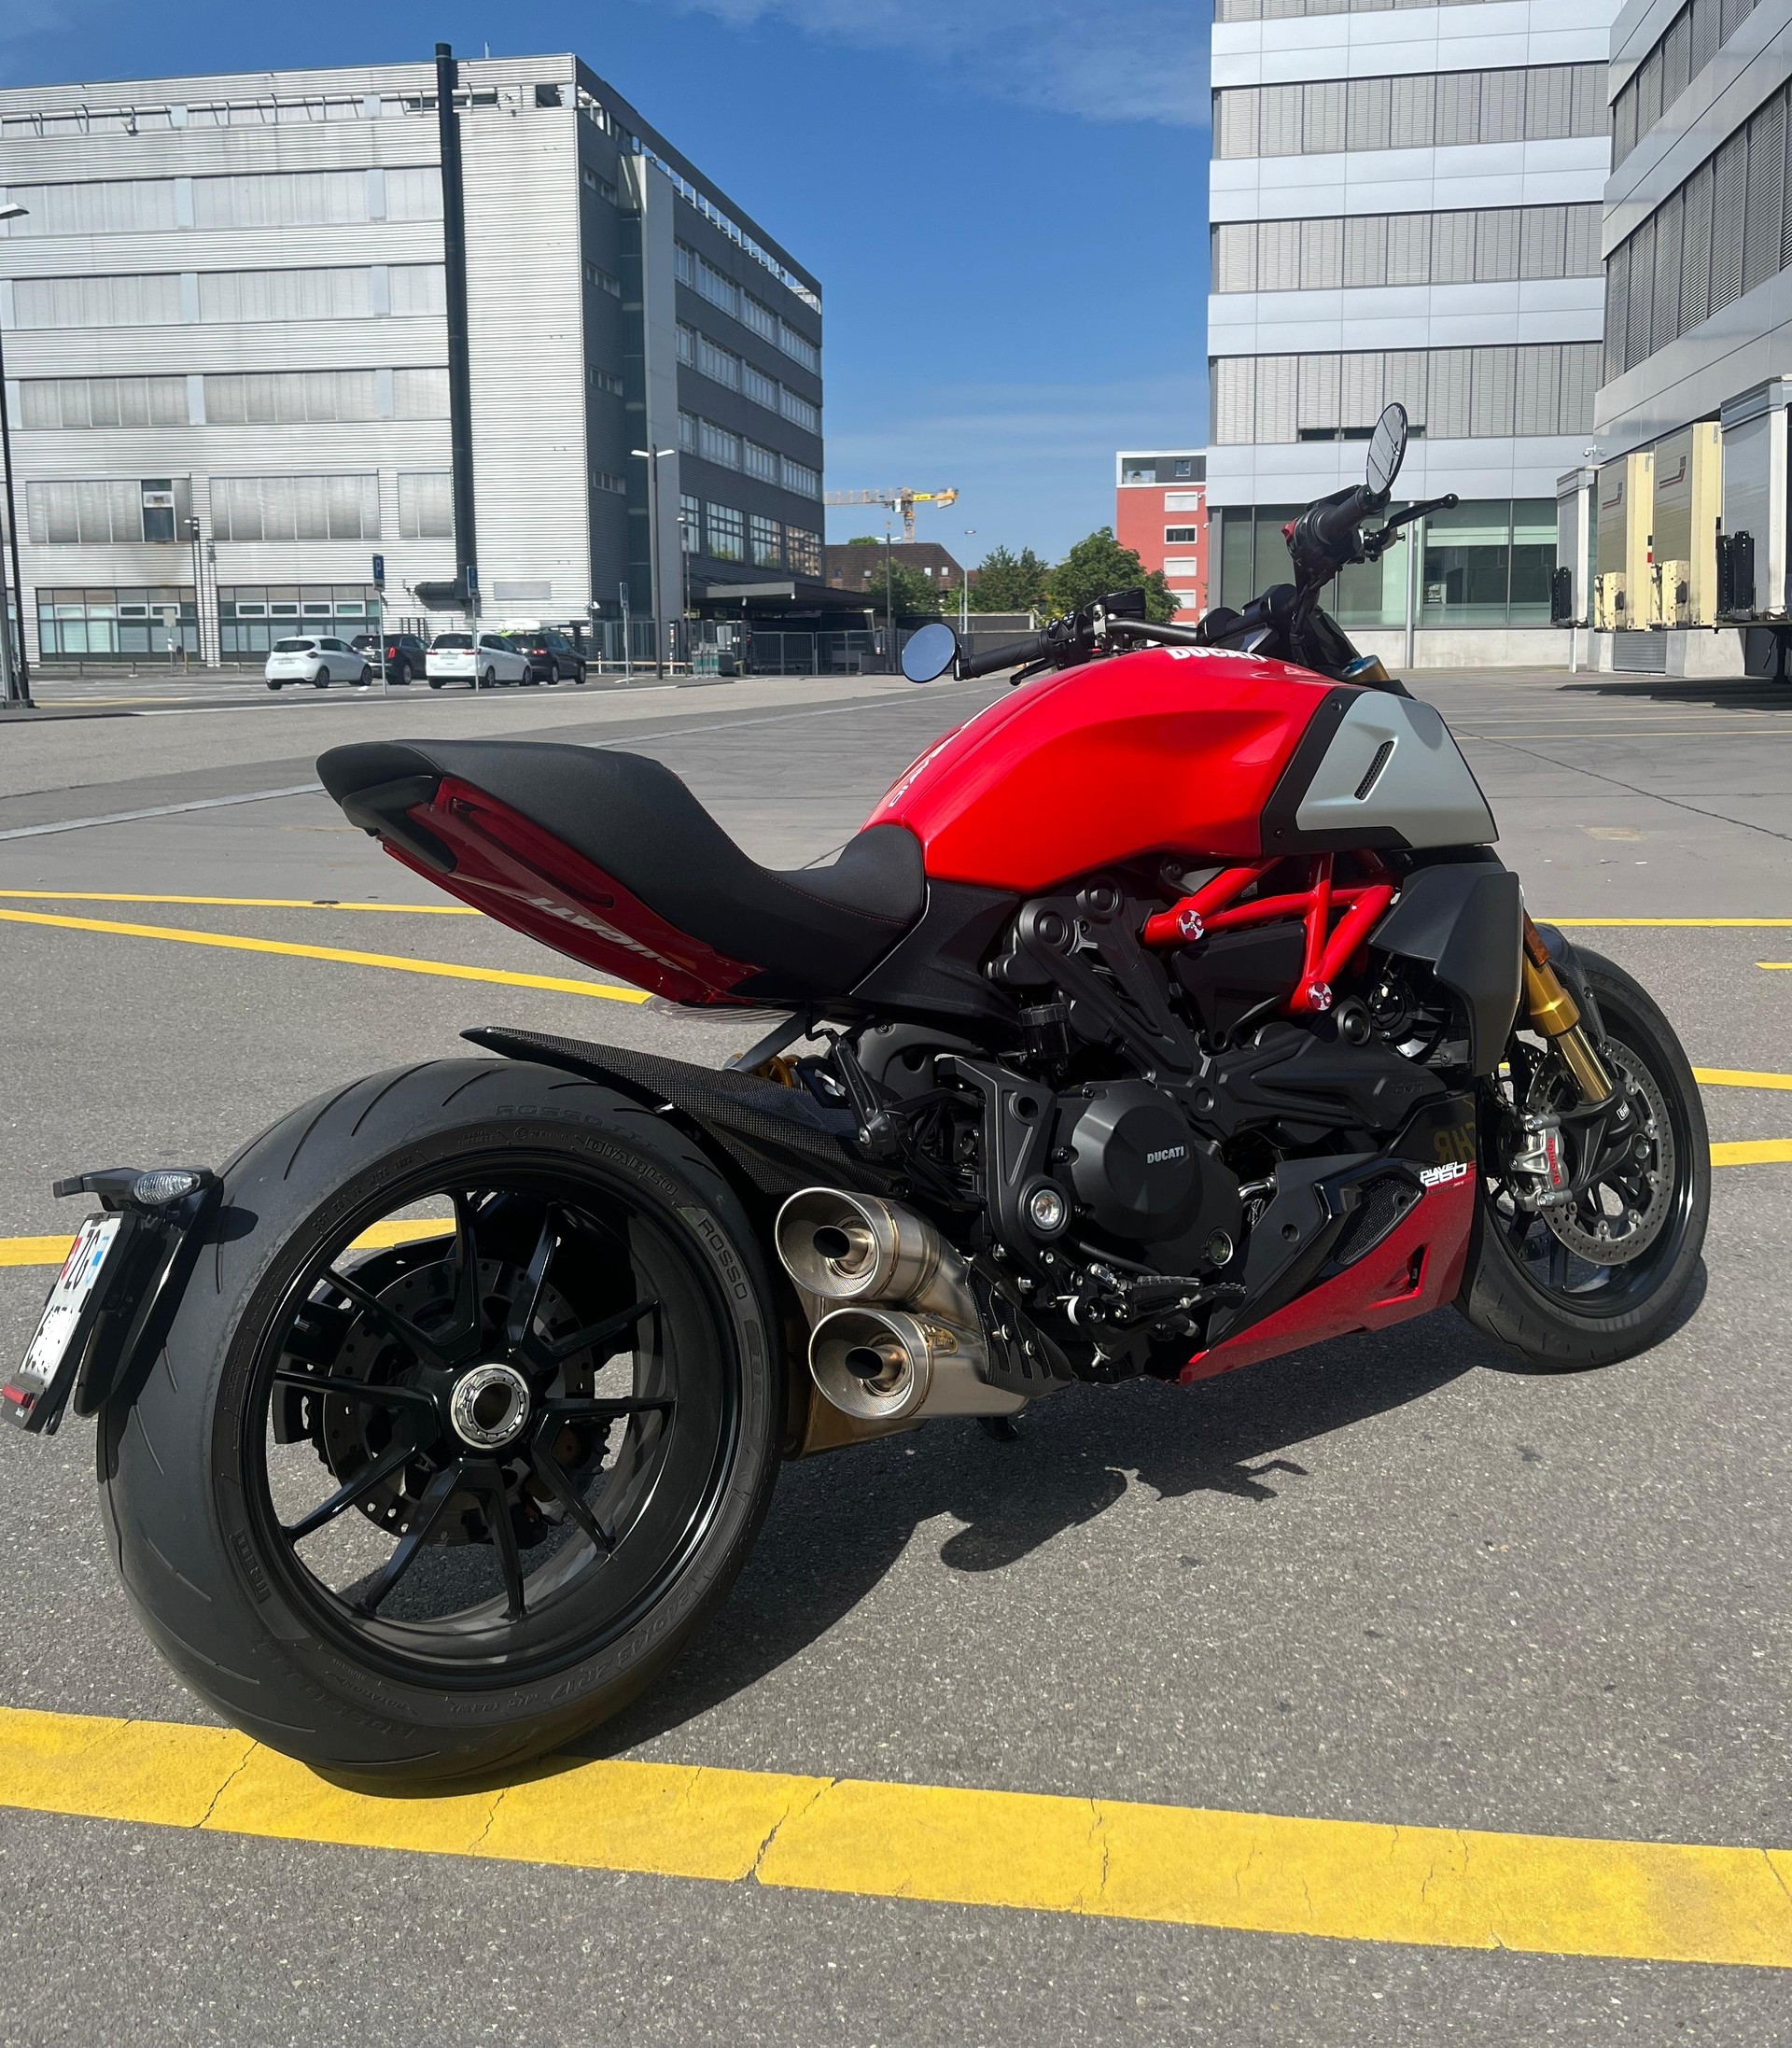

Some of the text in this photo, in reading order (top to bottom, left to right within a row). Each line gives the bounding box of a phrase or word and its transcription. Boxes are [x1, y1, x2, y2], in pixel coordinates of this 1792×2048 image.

[375, 559, 382, 577] P
[1165, 647, 1268, 663] DUCATI
[495, 1104, 605, 1127] ROSSO
[1146, 1145, 1185, 1166] DUCATI
[1547, 1137, 1561, 1185] brembo
[1420, 1161, 1459, 1177] DIAVEL
[584, 1137, 679, 1197] DIABLO
[696, 1217, 749, 1300] ROSSO
